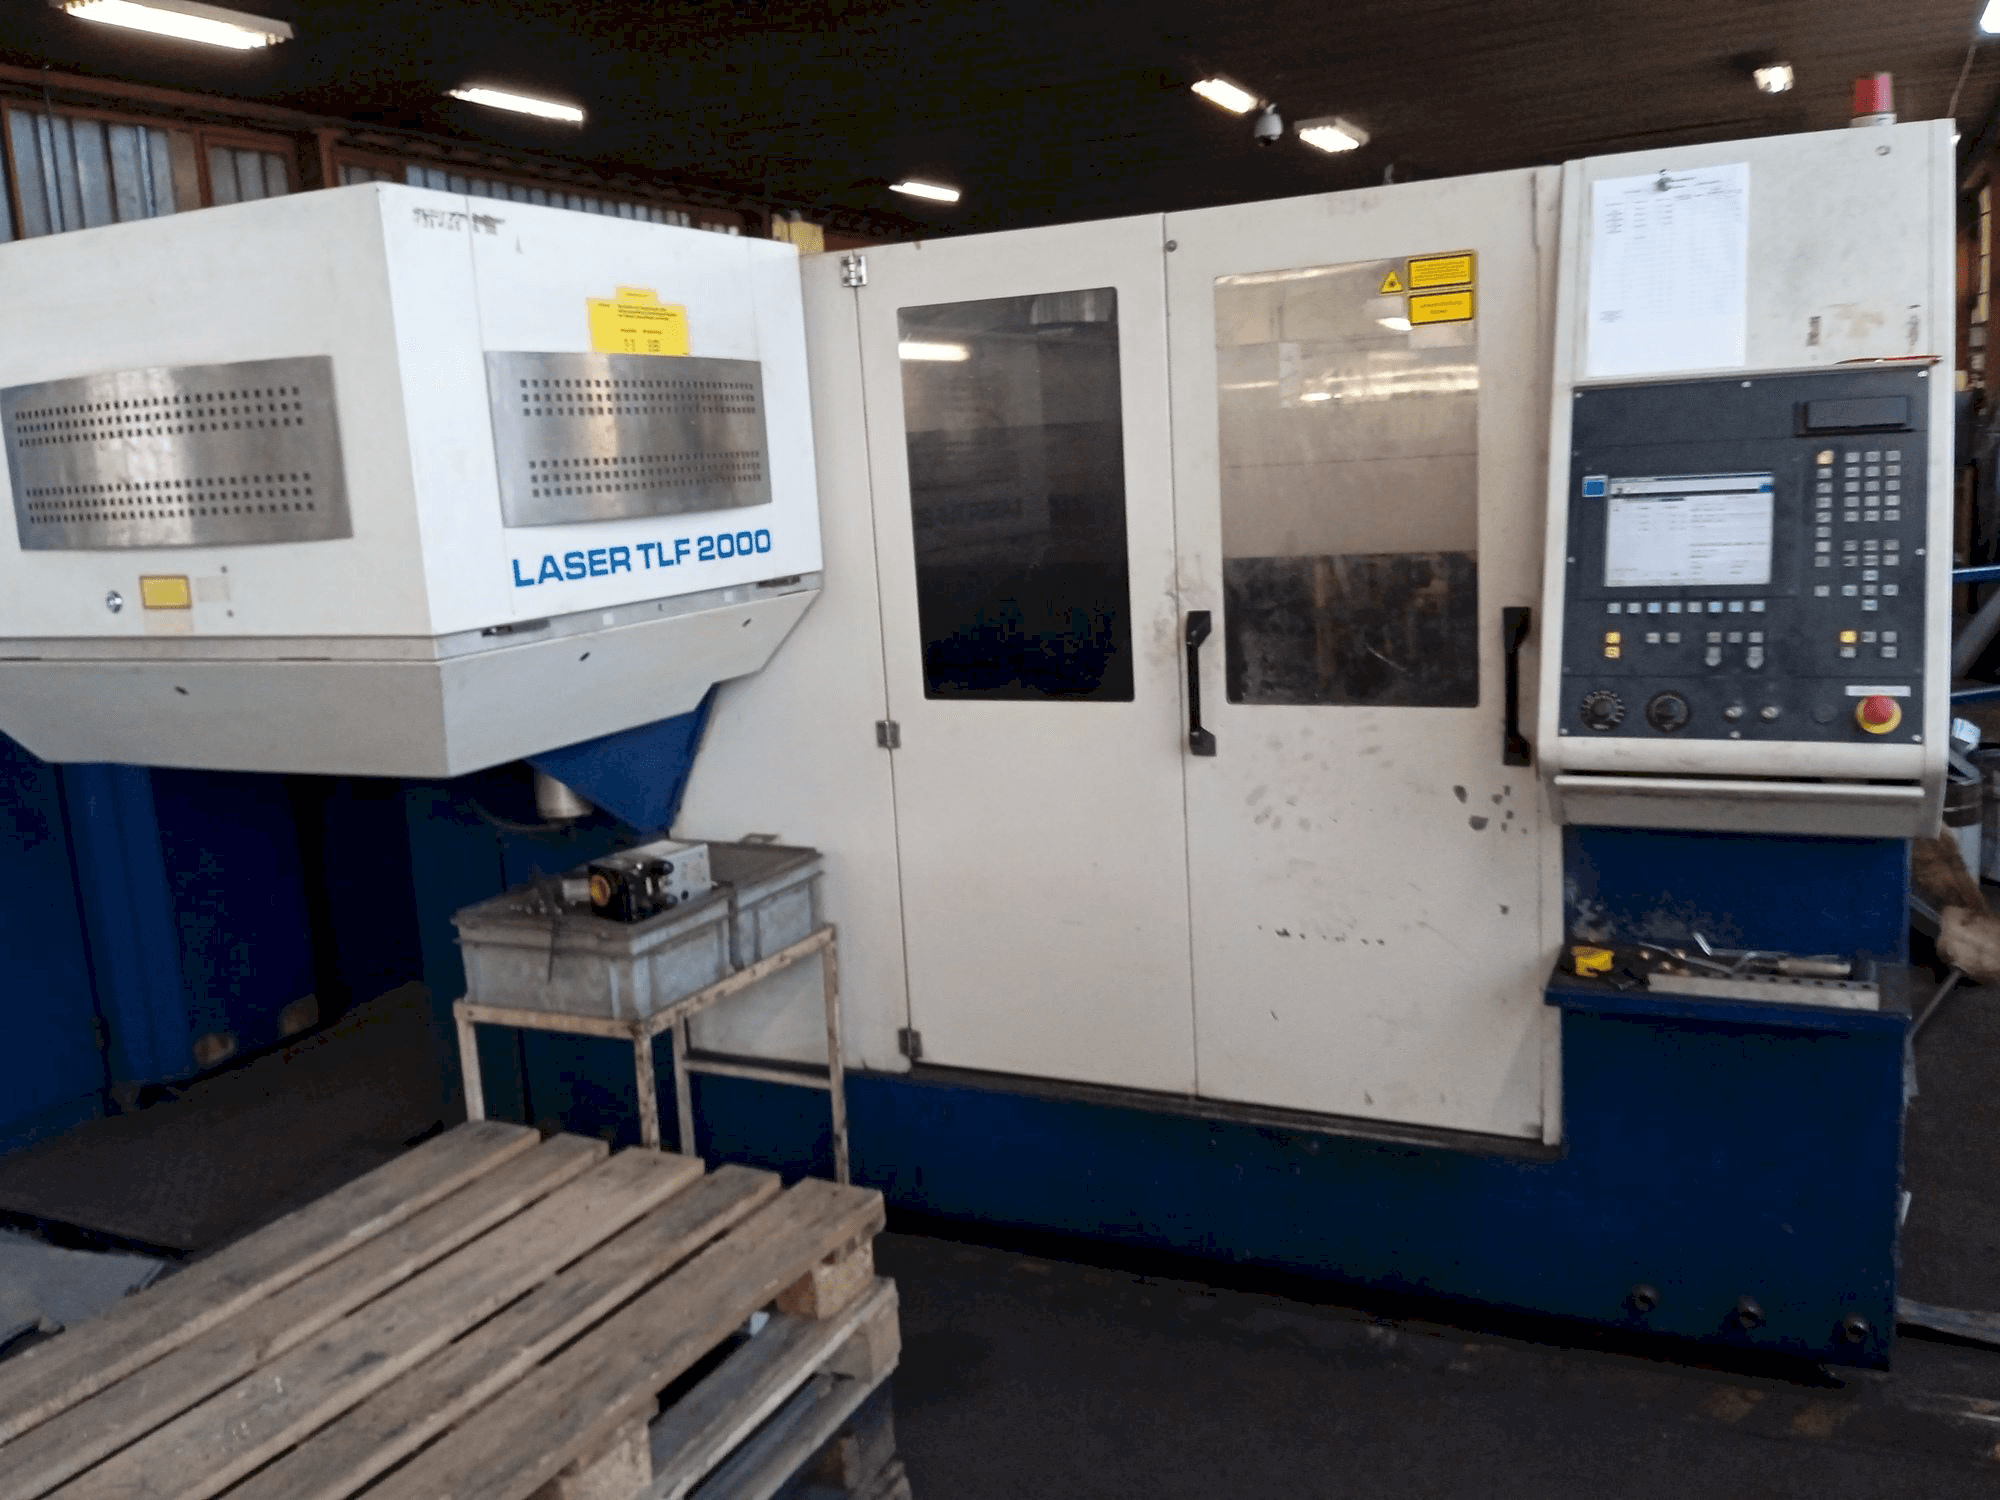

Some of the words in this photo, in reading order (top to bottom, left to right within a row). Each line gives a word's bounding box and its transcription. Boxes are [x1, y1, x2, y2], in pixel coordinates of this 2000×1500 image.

[512, 546, 632, 588] LASER
[636, 538, 691, 569] TLF
[697, 529, 772, 562] 2000
